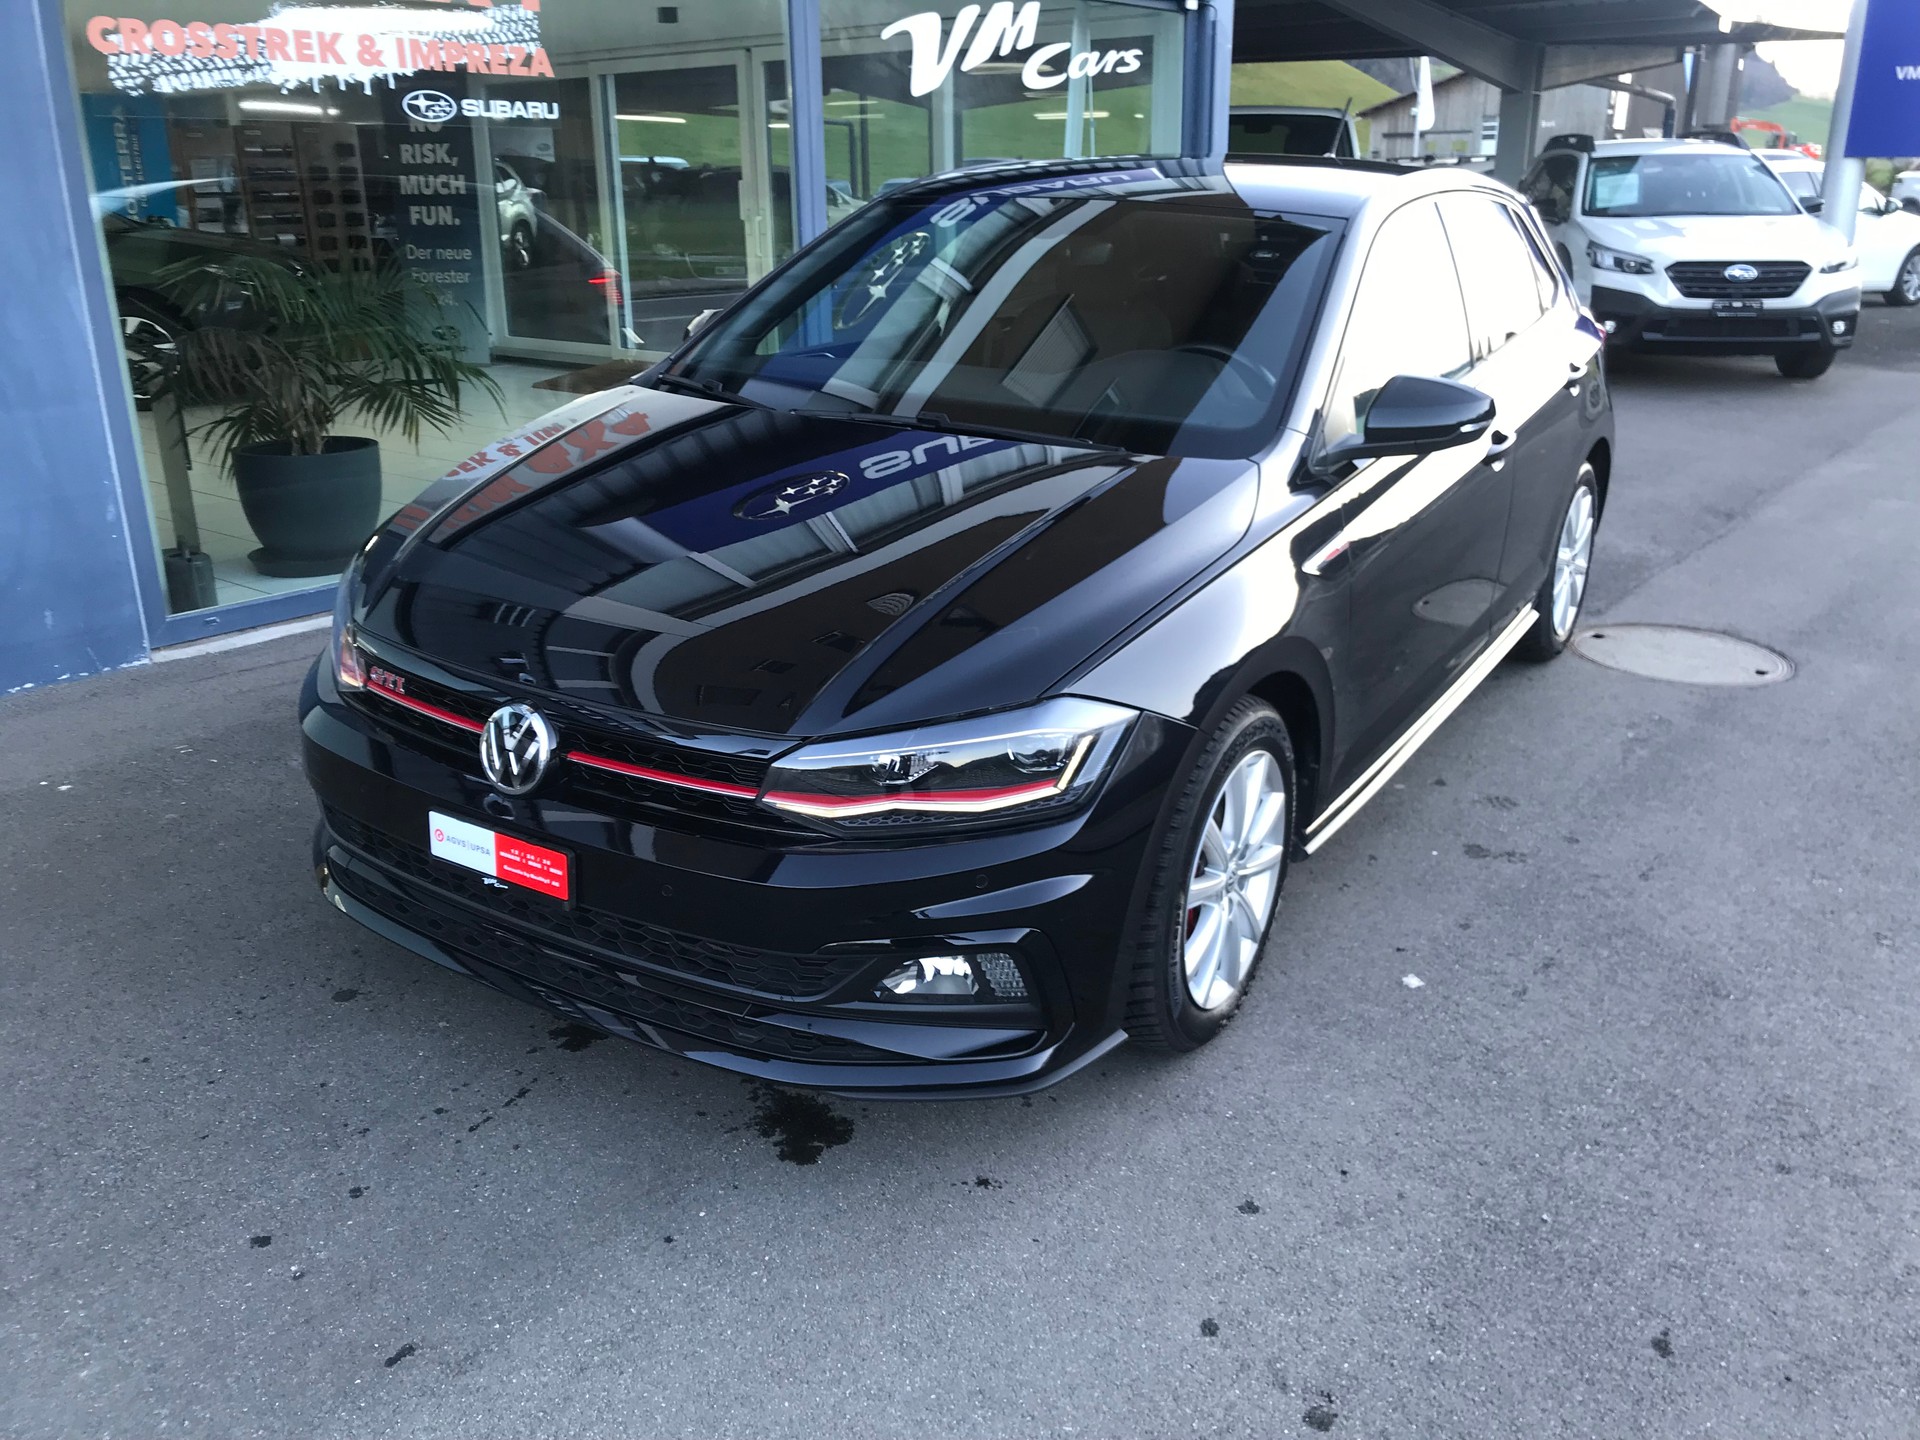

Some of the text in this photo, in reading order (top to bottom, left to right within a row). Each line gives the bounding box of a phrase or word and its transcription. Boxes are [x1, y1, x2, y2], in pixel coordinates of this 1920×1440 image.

[86, 16, 555, 78] CROSSTREK & IMPREZA
[880, 1, 1143, 97] VM Cars
[461, 99, 559, 120] SUBARU
[399, 143, 458, 166] RISK,
[399, 174, 466, 195] MUCH
[409, 205, 461, 226] FUN.
[405, 243, 473, 260] Der neue
[410, 266, 471, 283] Forester
[370, 666, 405, 694] GTI
